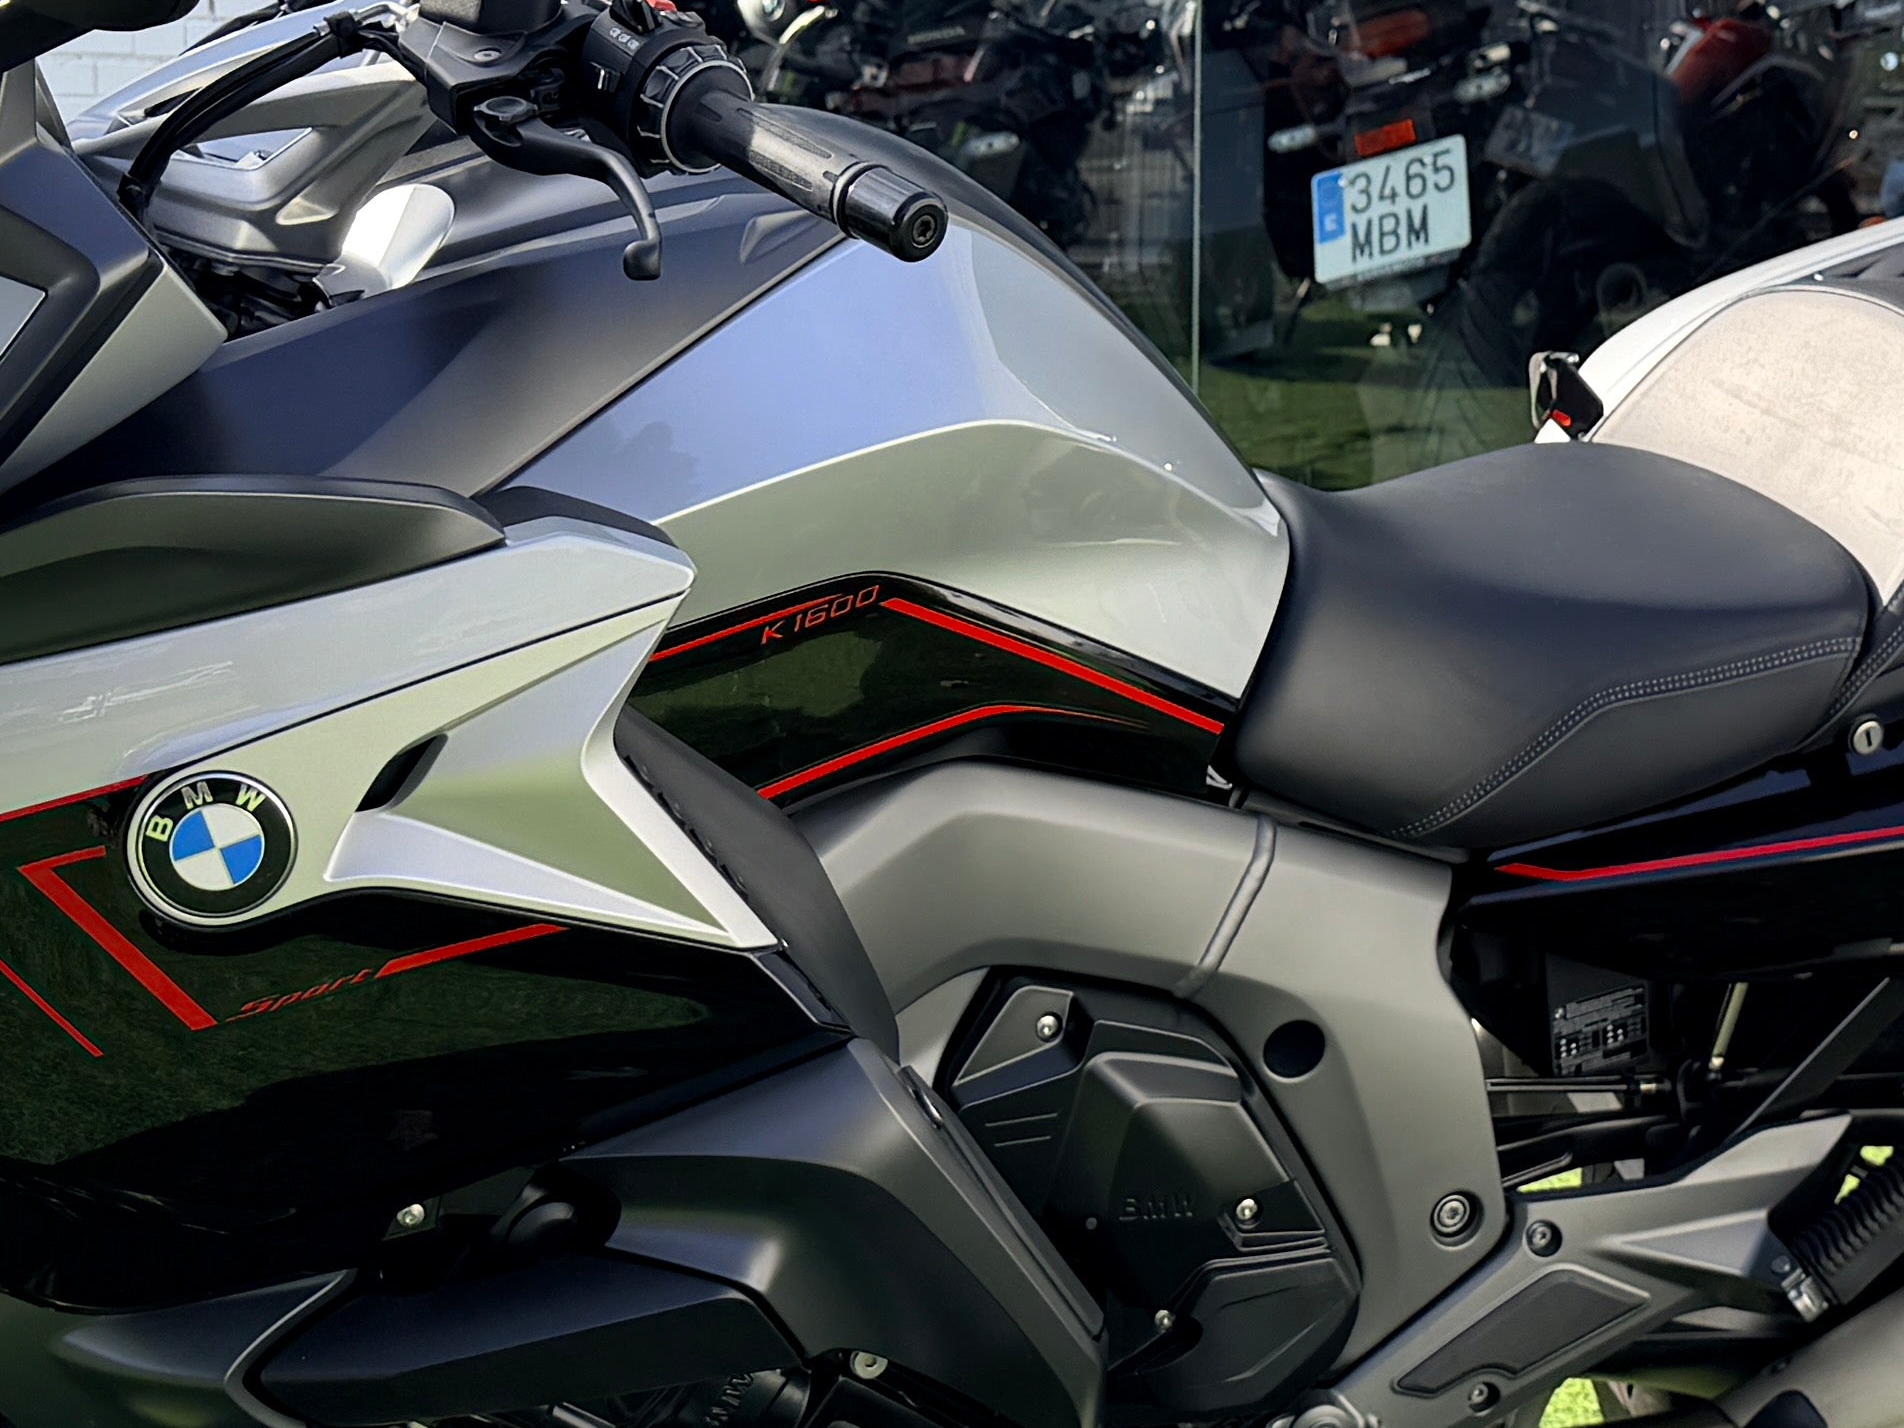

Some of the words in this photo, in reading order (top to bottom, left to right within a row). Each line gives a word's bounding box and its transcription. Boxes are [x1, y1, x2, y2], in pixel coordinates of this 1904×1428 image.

[1348, 148, 1456, 214] 3465
[1351, 203, 1430, 264] MBM
[760, 619, 786, 646] K
[793, 584, 880, 633] 1600
[145, 780, 267, 843] BMW
